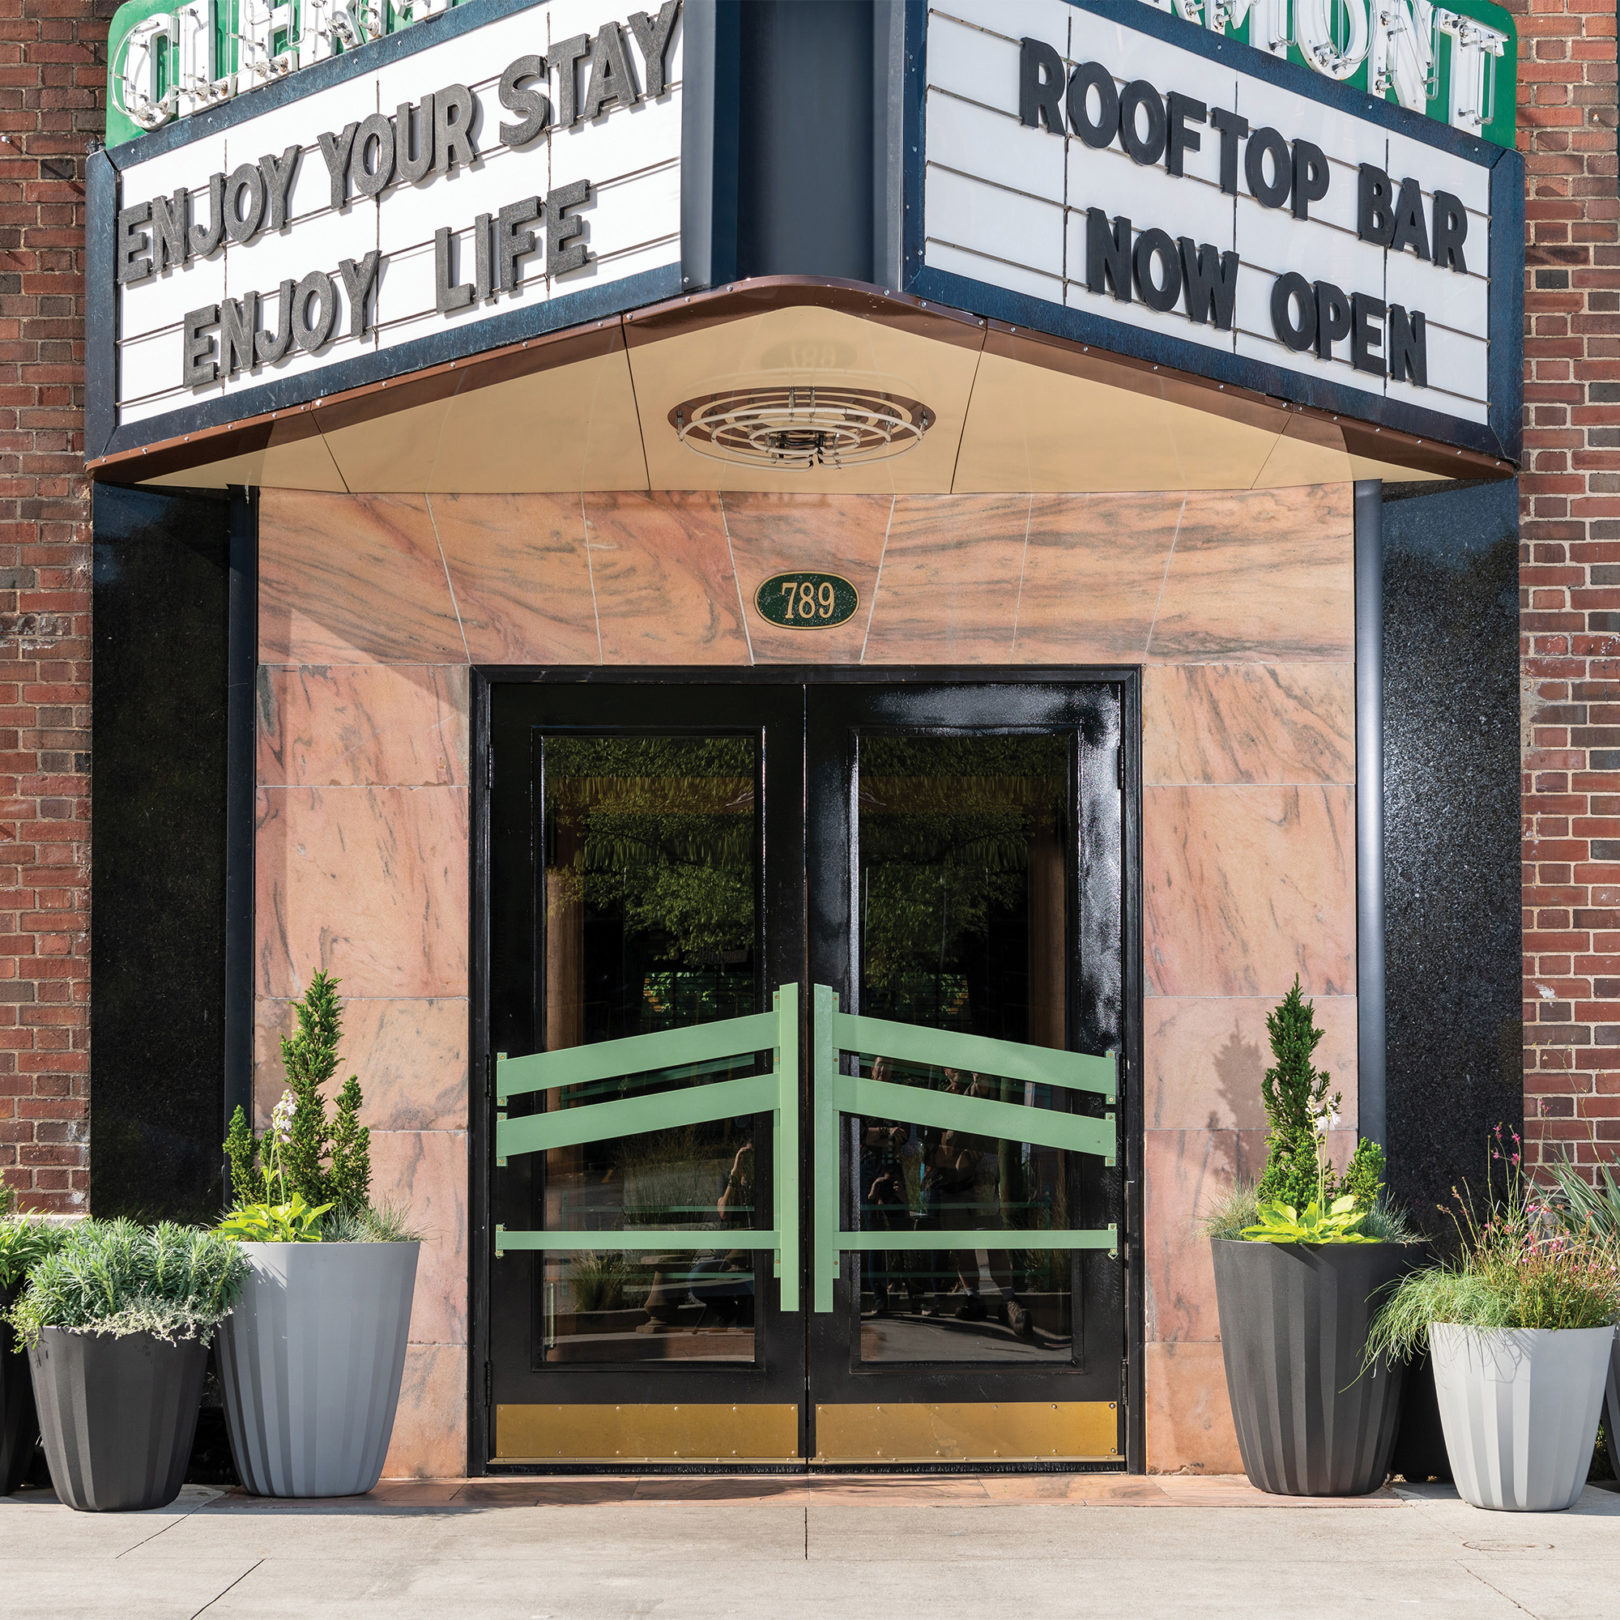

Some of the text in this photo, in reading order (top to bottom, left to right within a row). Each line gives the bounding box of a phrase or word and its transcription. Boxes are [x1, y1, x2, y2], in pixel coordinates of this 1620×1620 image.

[118, 0, 681, 285] ENJOY YOUR STAY
[1019, 37, 1468, 274] ROOFTOP BAR
[183, 179, 591, 388] ENJOY LIFE
[1086, 207, 1428, 388] NOW OPEN
[781, 582, 835, 619] 789
